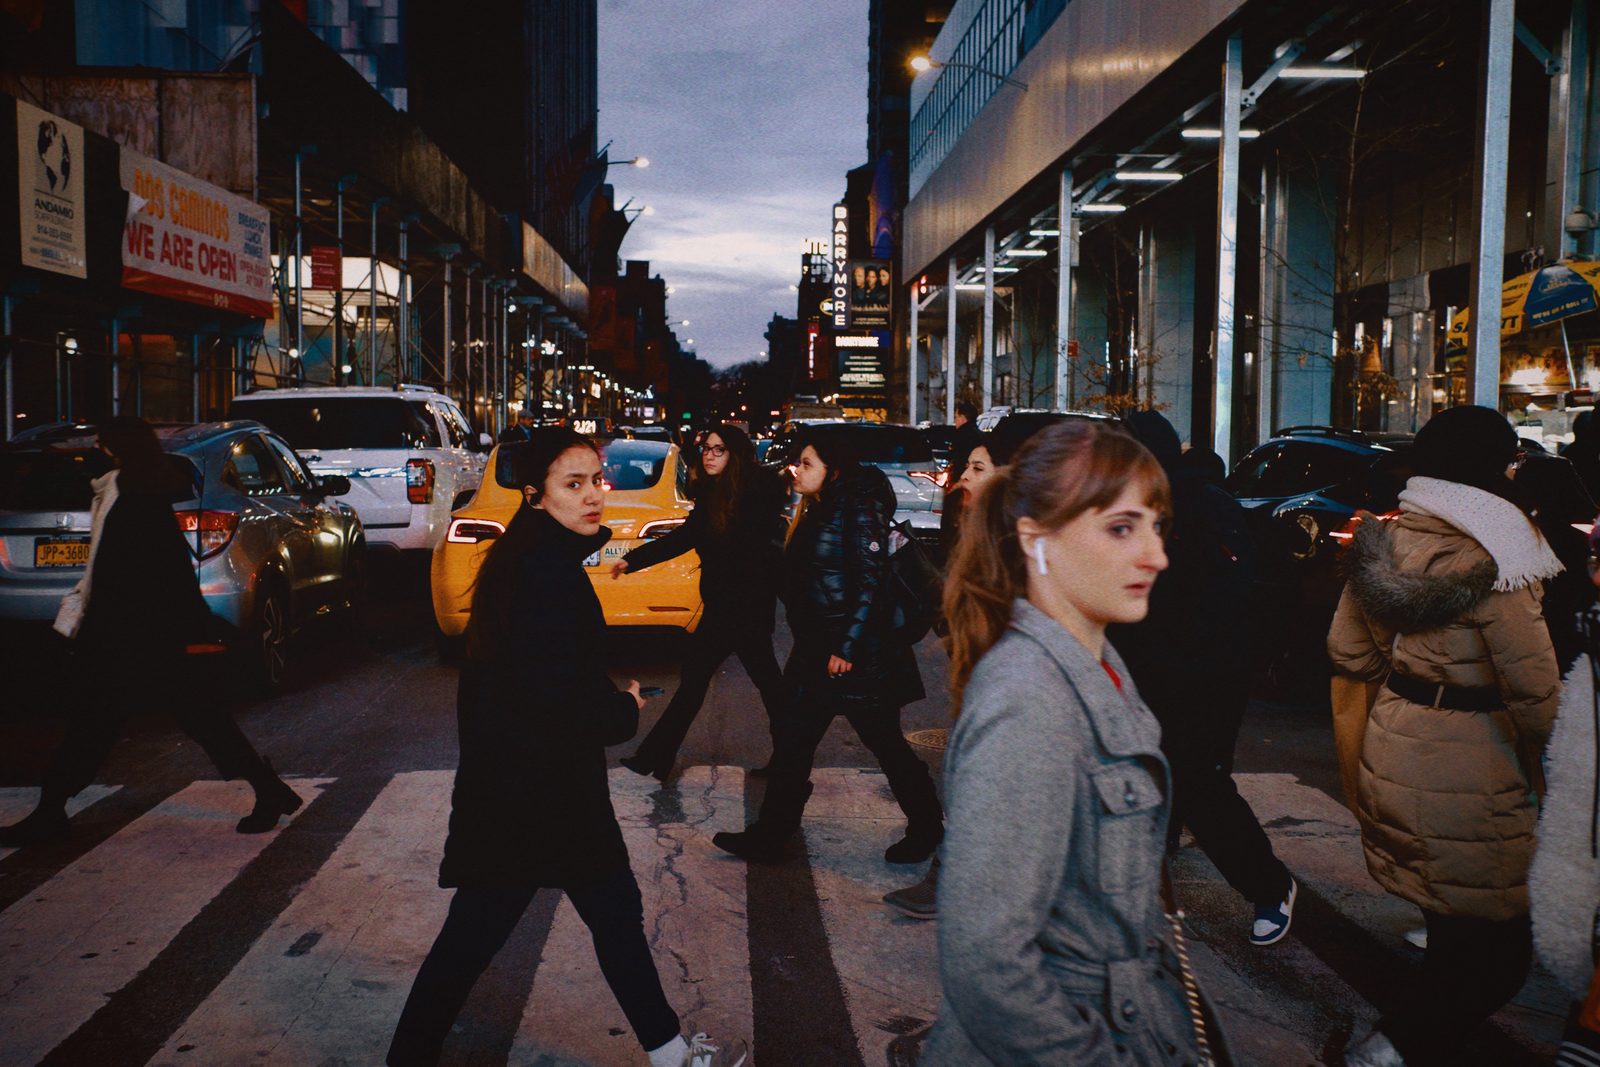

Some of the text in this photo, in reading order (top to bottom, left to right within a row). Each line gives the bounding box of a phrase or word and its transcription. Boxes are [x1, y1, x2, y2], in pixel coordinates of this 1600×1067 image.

[34, 197, 74, 219] ANDAMIO
[169, 182, 230, 242] CAMINOS
[126, 222, 237, 283] WE ARE OPEN
[834, 206, 847, 326] BARRYMORE
